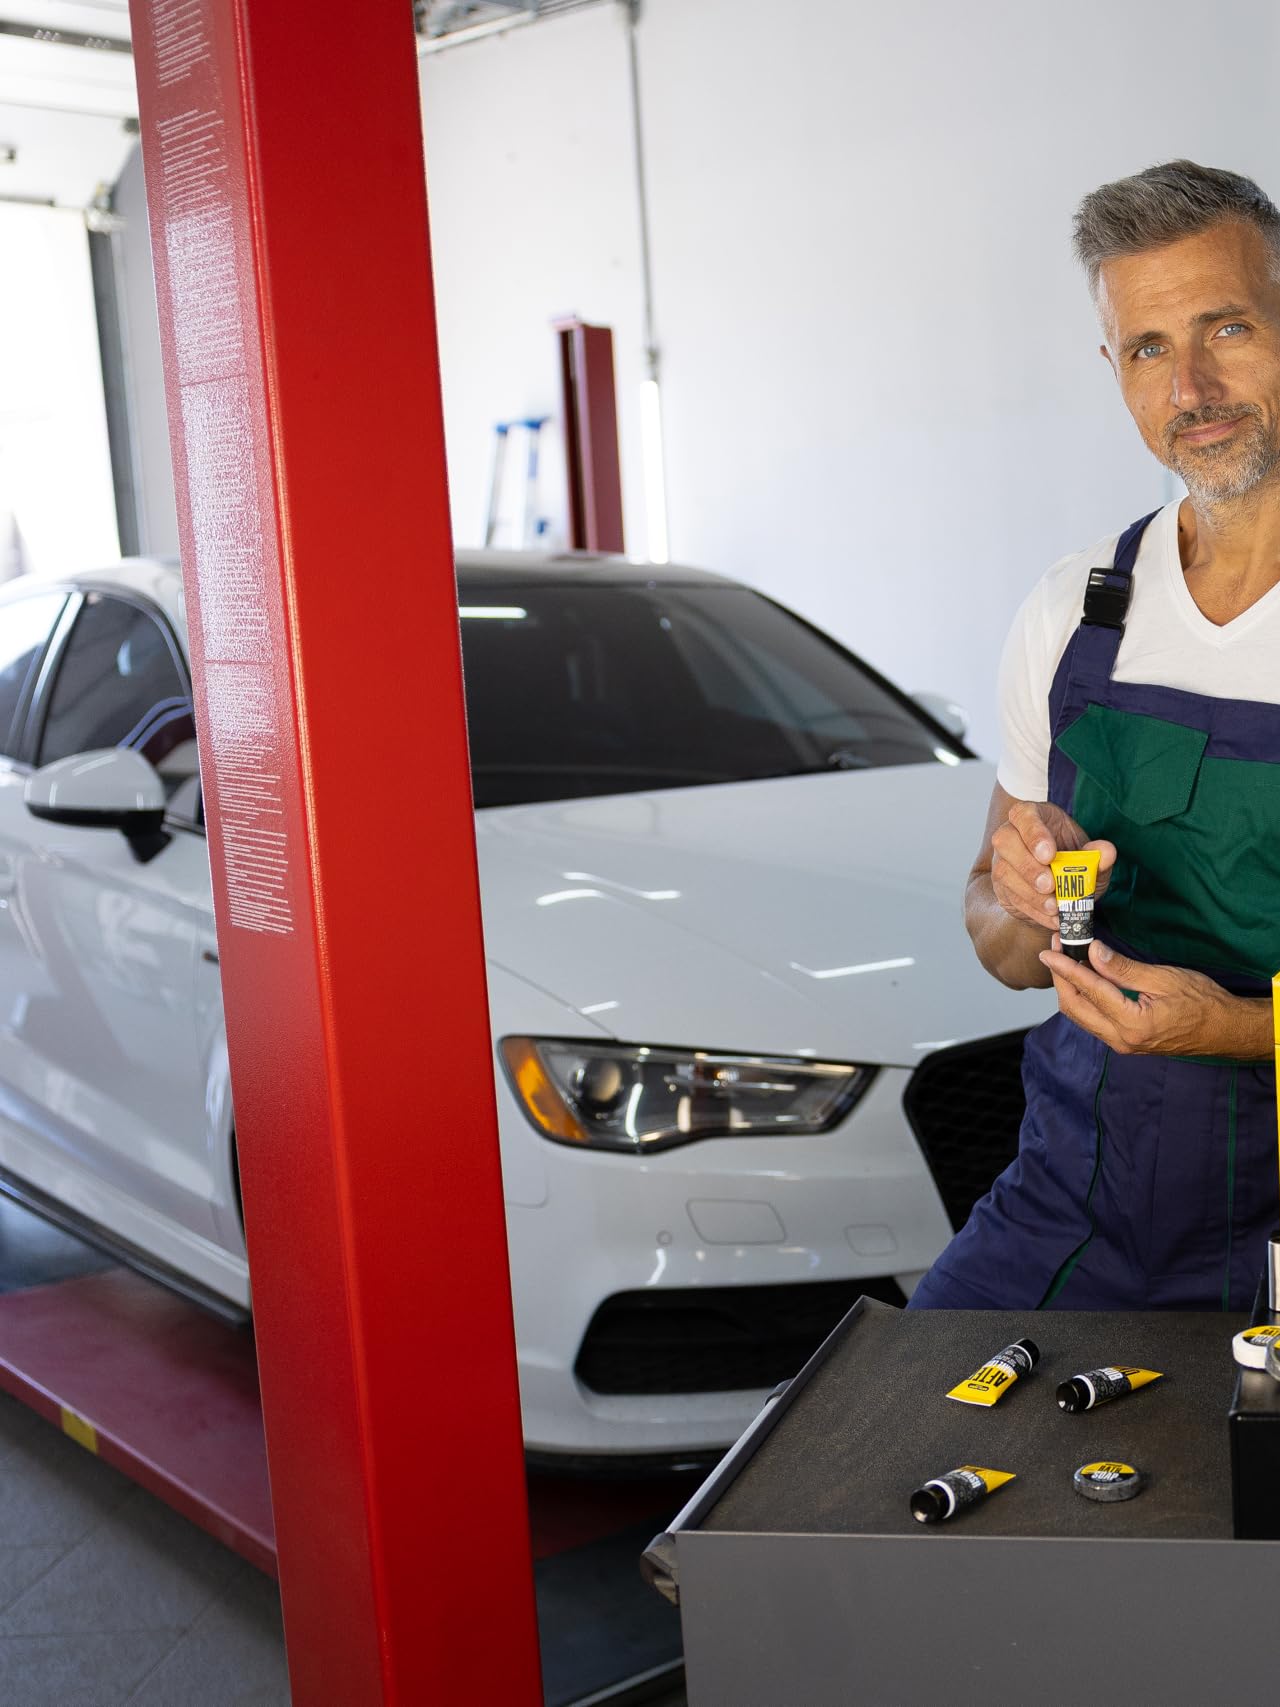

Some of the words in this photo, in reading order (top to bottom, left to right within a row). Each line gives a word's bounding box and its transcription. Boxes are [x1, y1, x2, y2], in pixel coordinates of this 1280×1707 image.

[1056, 874, 1085, 898] HAND
[1074, 899, 1095, 912] LOTION
[1097, 1465, 1123, 1473] BATH
[1090, 1471, 1120, 1481] SOAP
